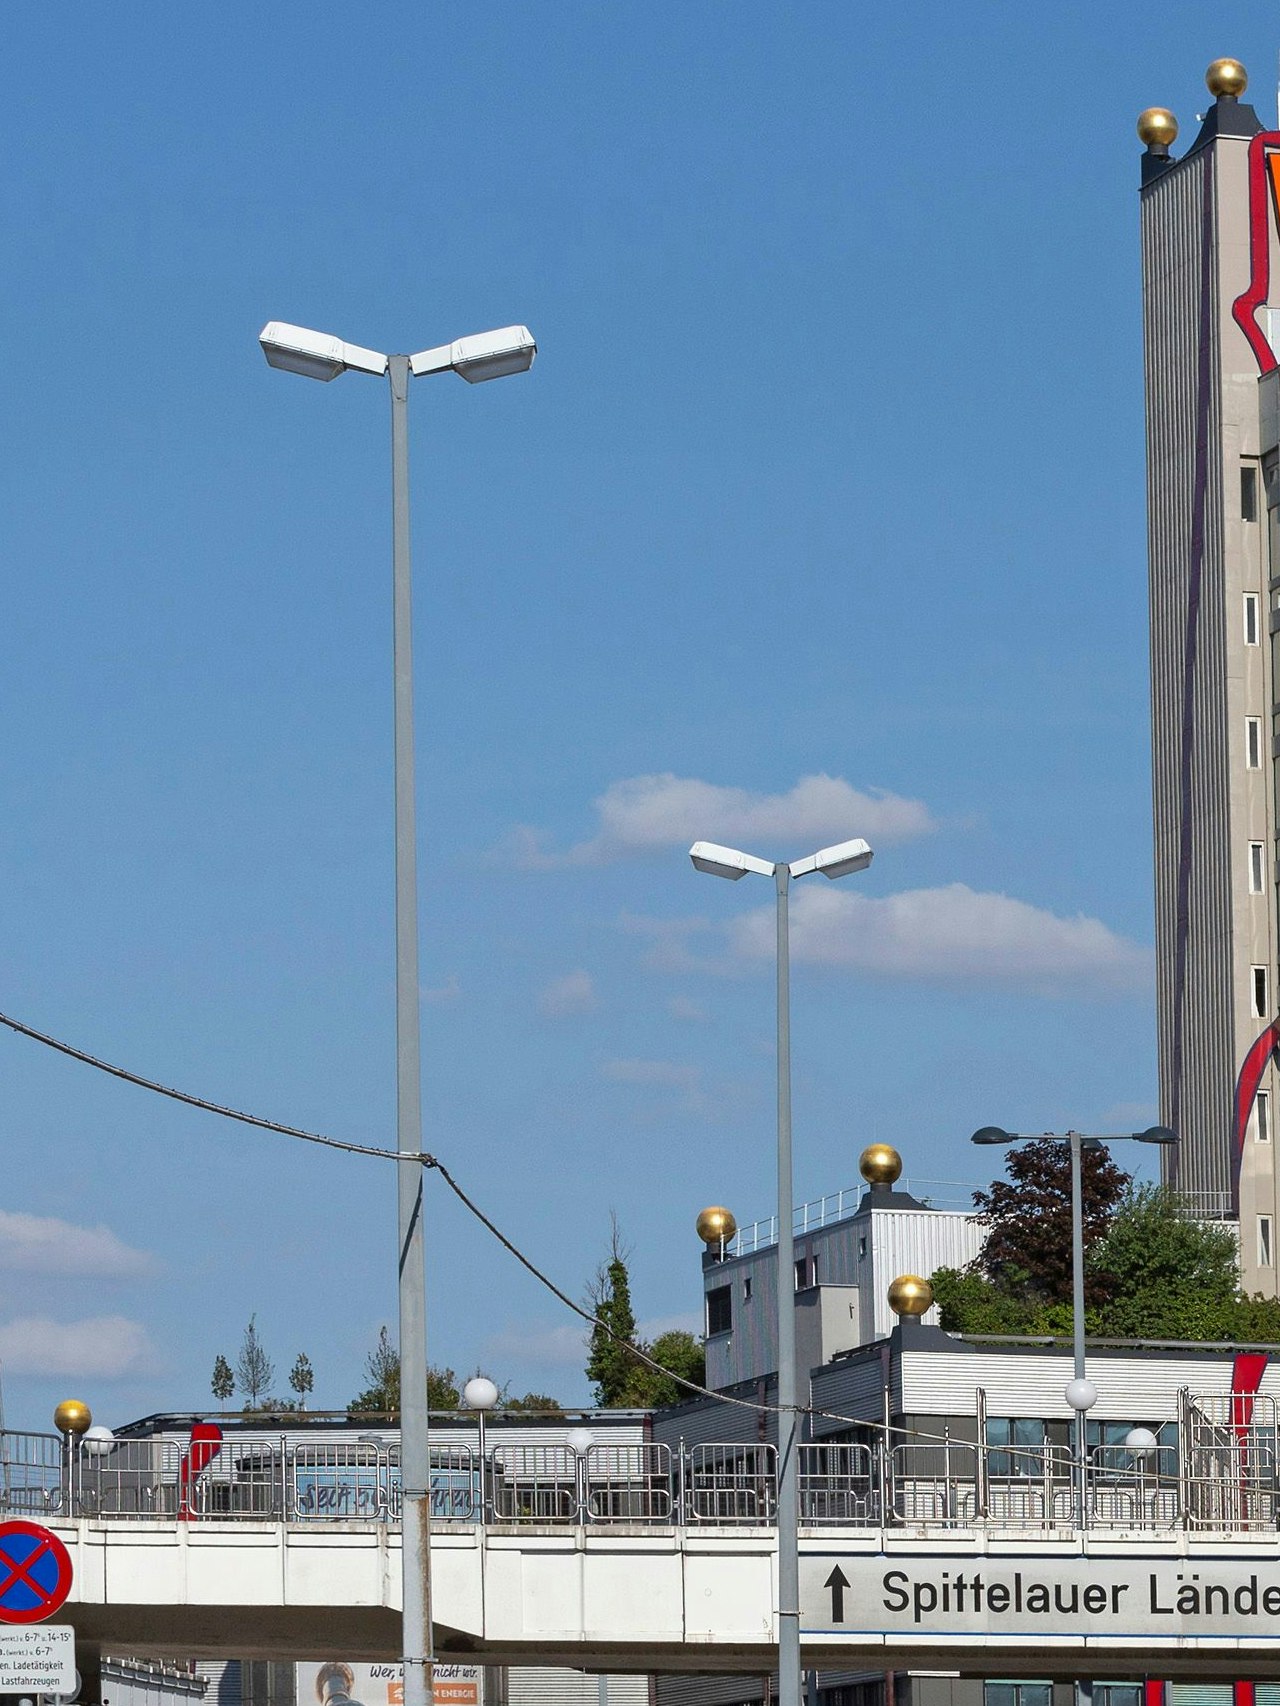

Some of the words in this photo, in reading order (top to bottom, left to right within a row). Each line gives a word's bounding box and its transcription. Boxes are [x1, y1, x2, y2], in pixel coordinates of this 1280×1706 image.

[881, 1570, 1129, 1623] Spittelauer
[13, 1661, 64, 1672] Ladetätigkeit
[1, 1676, 60, 1687] Lastfahrzeugen
[441, 1689, 475, 1698] ENERGIE
